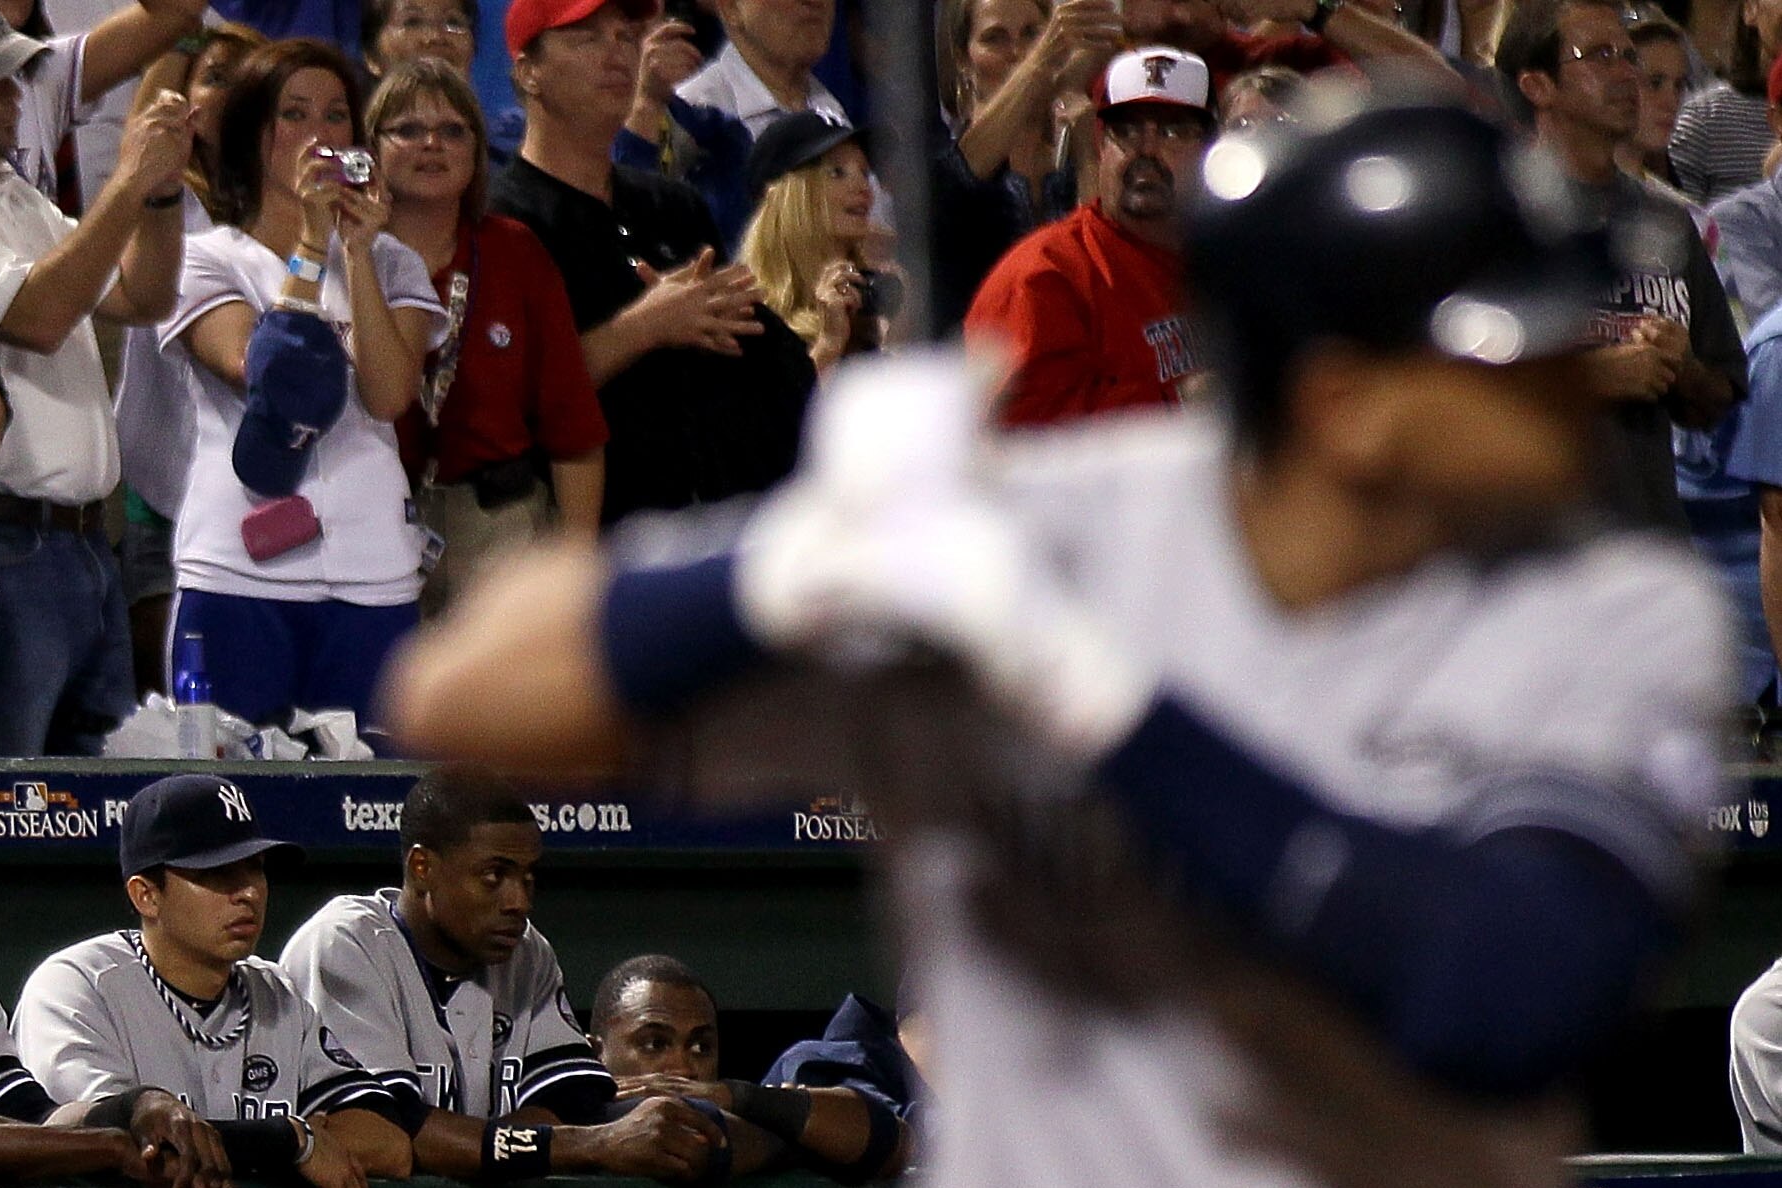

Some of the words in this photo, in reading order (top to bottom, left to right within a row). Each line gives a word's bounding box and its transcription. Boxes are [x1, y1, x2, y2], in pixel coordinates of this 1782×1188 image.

[105, 800, 130, 828] FO
[218, 785, 252, 822] NY
[1748, 798, 1769, 819] tbs
[794, 812, 878, 841] POSTSEA
[510, 1128, 538, 1153] 14
